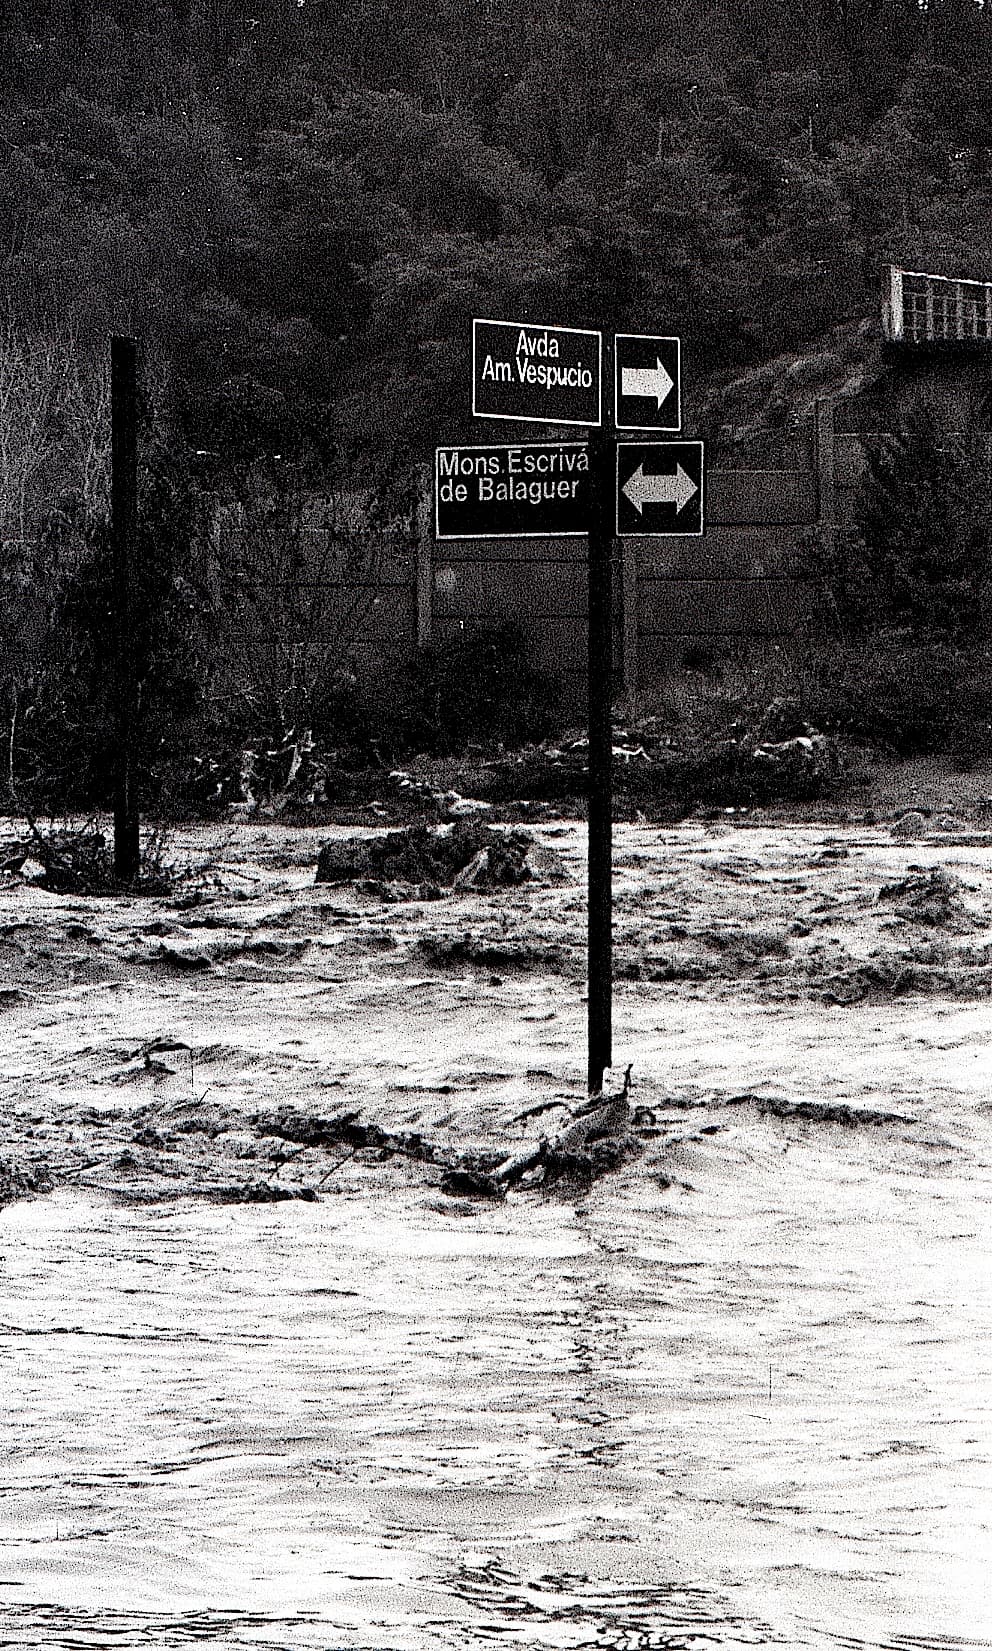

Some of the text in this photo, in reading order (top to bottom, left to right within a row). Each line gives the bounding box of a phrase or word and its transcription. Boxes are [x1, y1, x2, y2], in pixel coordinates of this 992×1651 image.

[515, 329, 559, 358] Avda
[481, 355, 592, 390] Am. Vespucio
[439, 452, 505, 476] Mons.
[440, 476, 580, 504] de Balaguer
